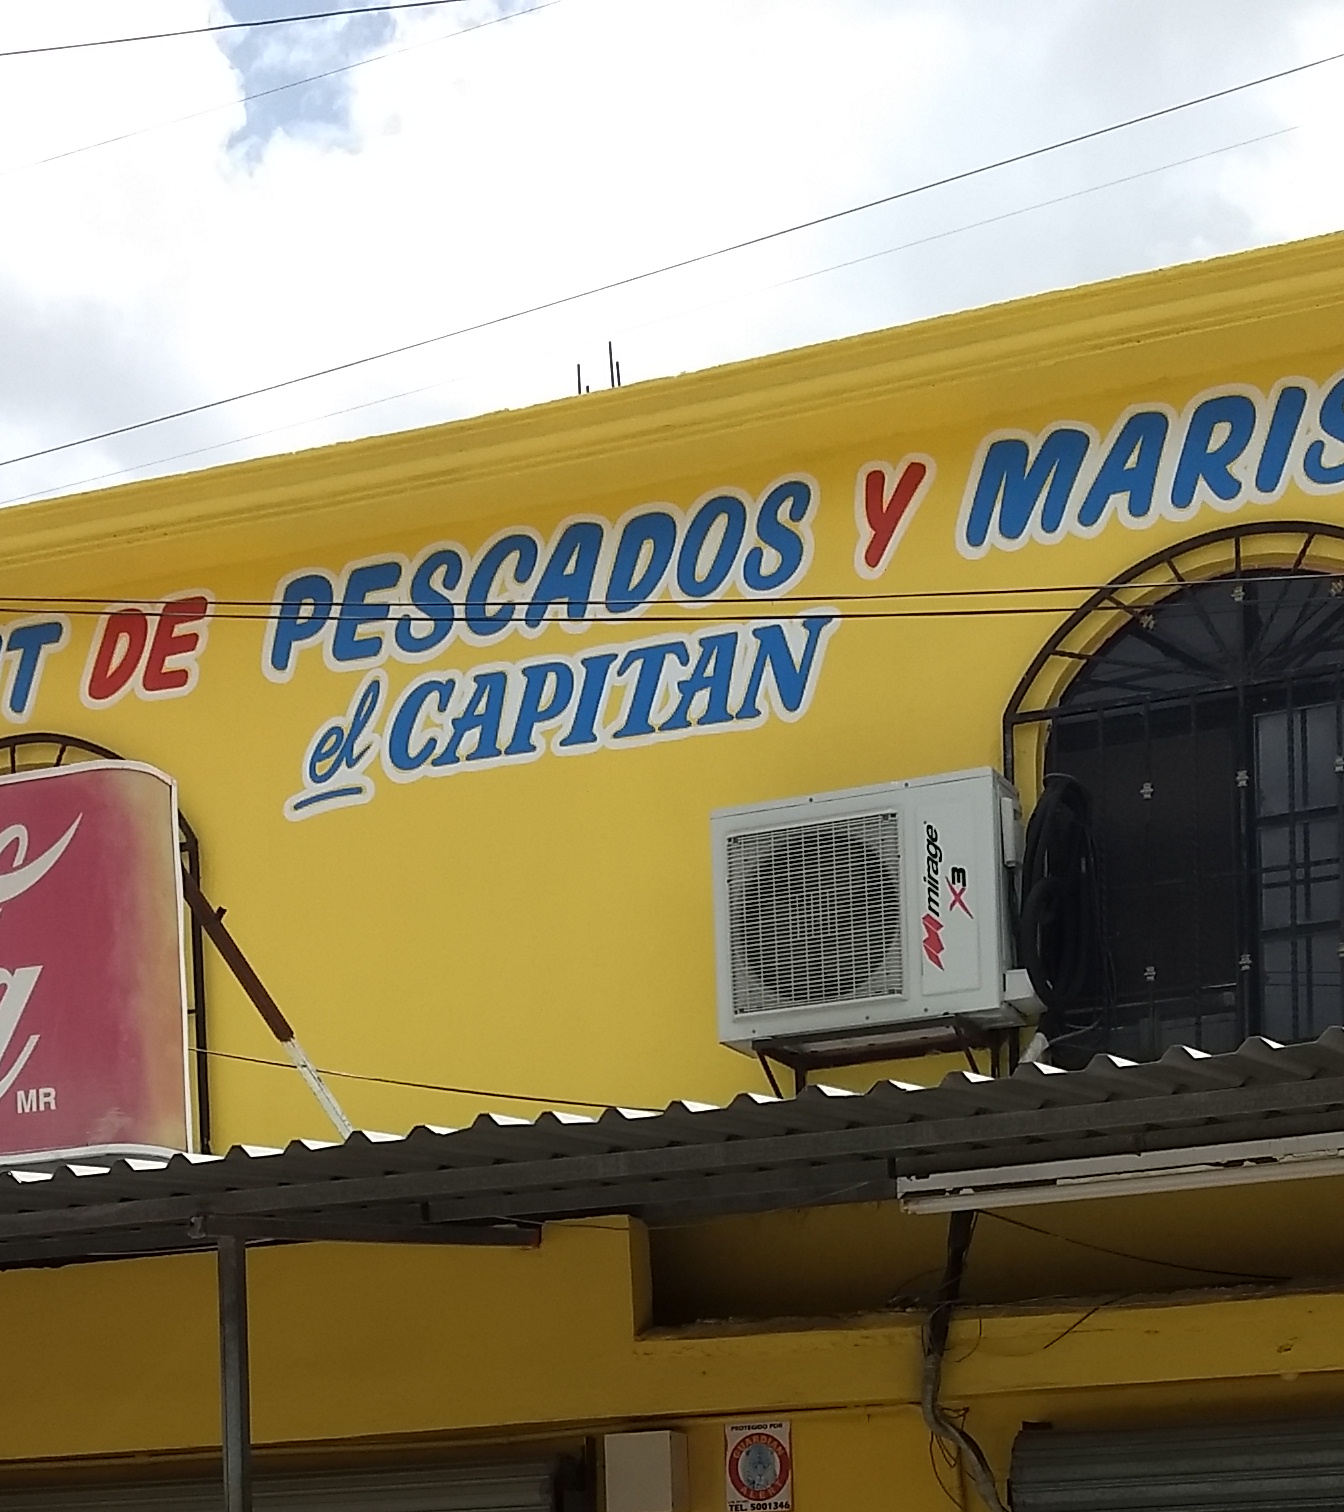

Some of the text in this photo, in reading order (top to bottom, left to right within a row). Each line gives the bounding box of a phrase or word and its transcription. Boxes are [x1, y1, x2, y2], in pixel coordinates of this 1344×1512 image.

[86, 596, 209, 700] DE
[270, 480, 812, 673] PESCADOS
[864, 462, 927, 568] Y
[308, 616, 833, 784] el CAPITAN
[945, 866, 974, 920] X3
[16, 1088, 57, 1114] MR
[728, 1504, 748, 1512] TEL.
[750, 1501, 790, 1511] 5001346
